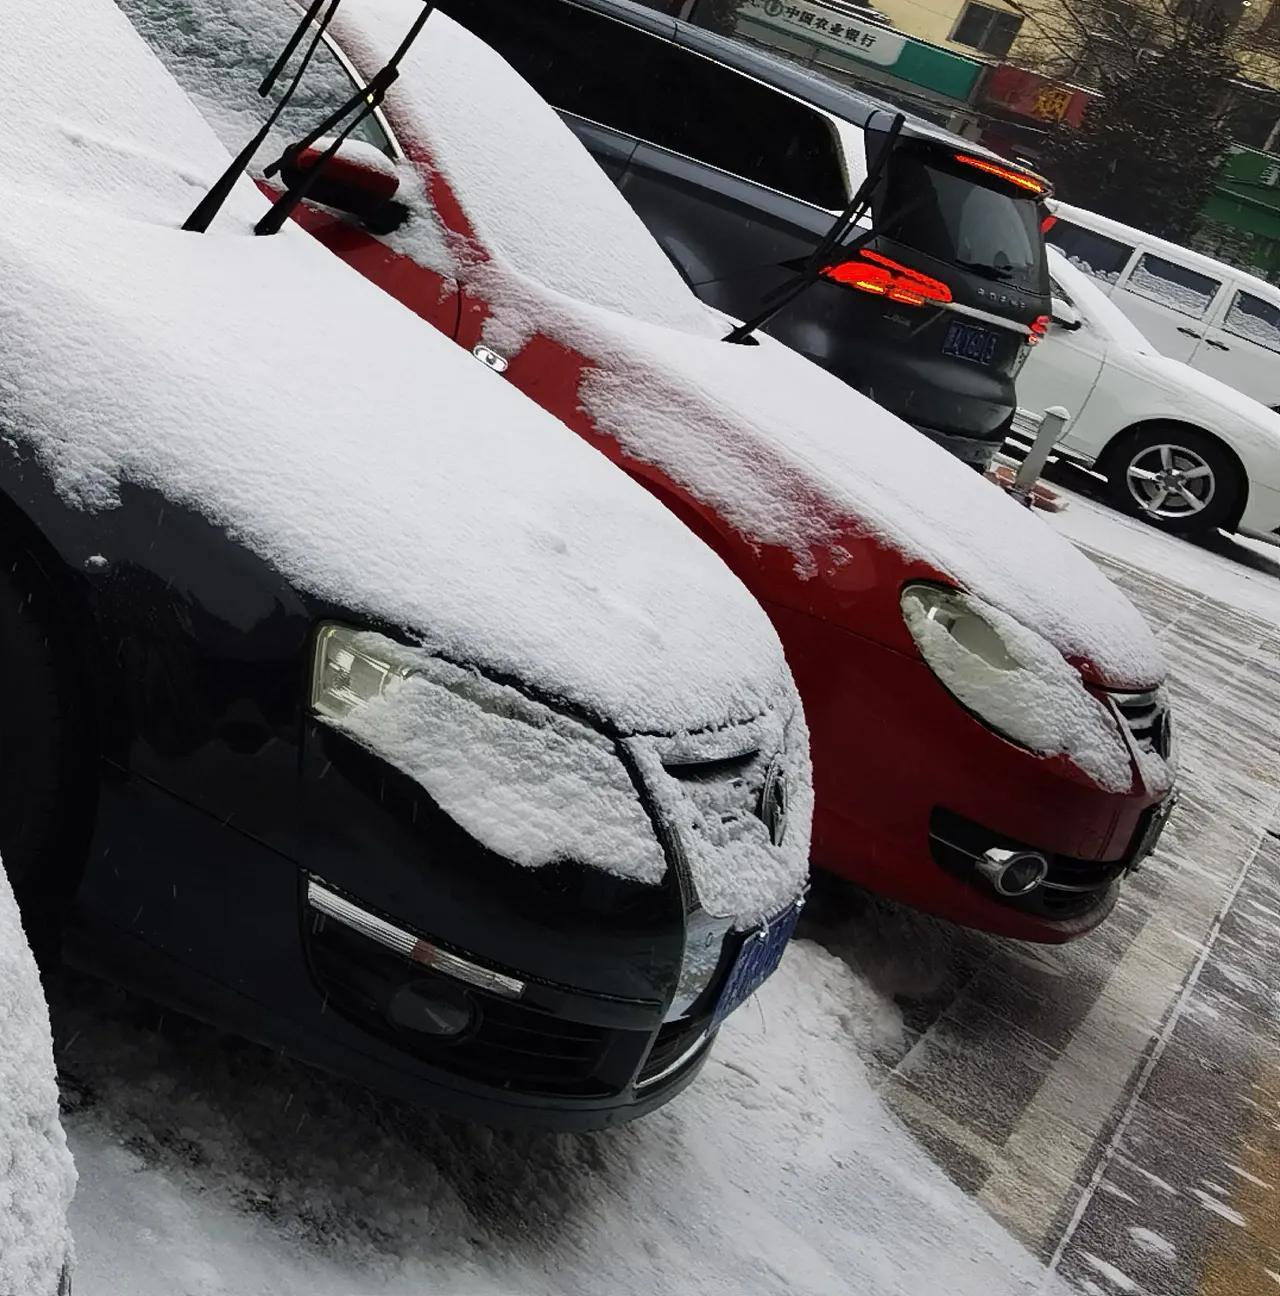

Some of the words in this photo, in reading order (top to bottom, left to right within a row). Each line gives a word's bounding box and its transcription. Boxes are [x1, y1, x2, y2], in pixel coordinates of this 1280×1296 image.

[784, 4, 878, 48] 中国农业银行
